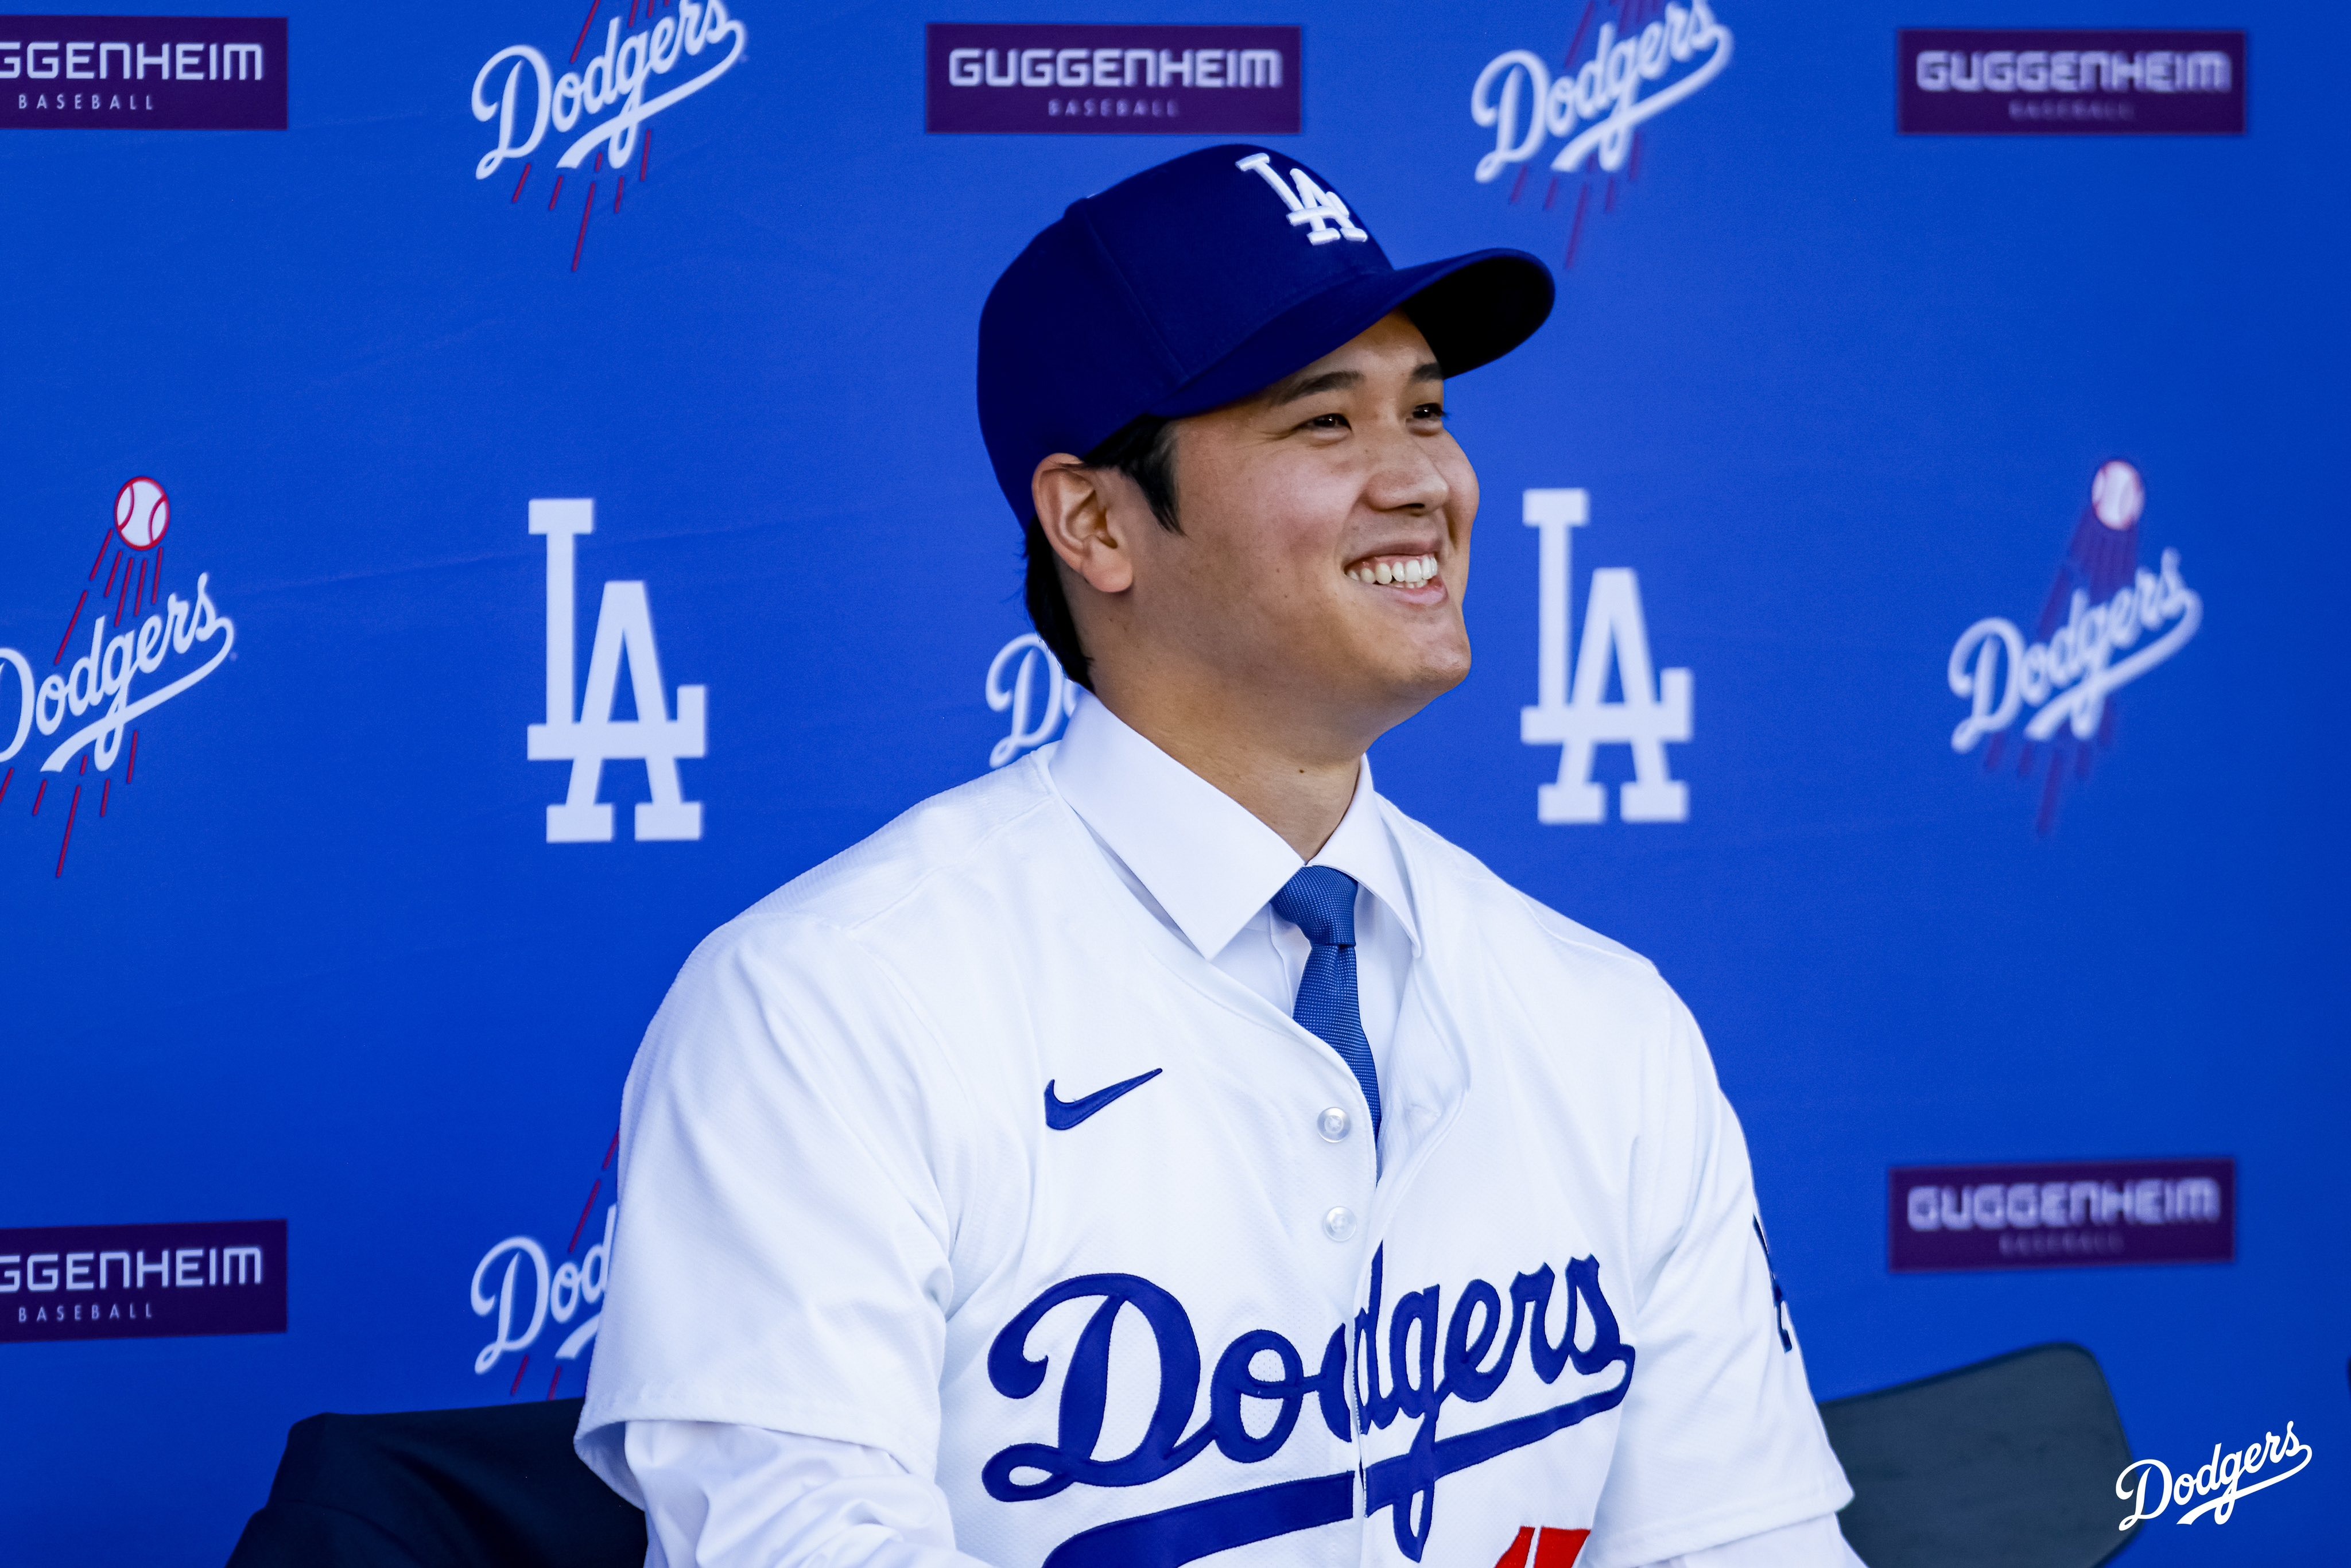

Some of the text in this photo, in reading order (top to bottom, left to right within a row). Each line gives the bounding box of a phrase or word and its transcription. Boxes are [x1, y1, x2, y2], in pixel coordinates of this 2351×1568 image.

[19, 94, 153, 110] BASEBALL
[471, 0, 745, 179] Dodgers
[949, 49, 1283, 87] GUGGENHEIM
[1471, 0, 1733, 183] Dodgers
[1917, 51, 2232, 92] GUGGENHEIM
[1235, 153, 1368, 246] LA
[527, 498, 706, 843] LA
[1521, 488, 1693, 824] LA
[1947, 547, 2202, 752] Dodgers
[18, 1303, 152, 1322] BASEBALL
[982, 1240, 1635, 1568] Dodgers
